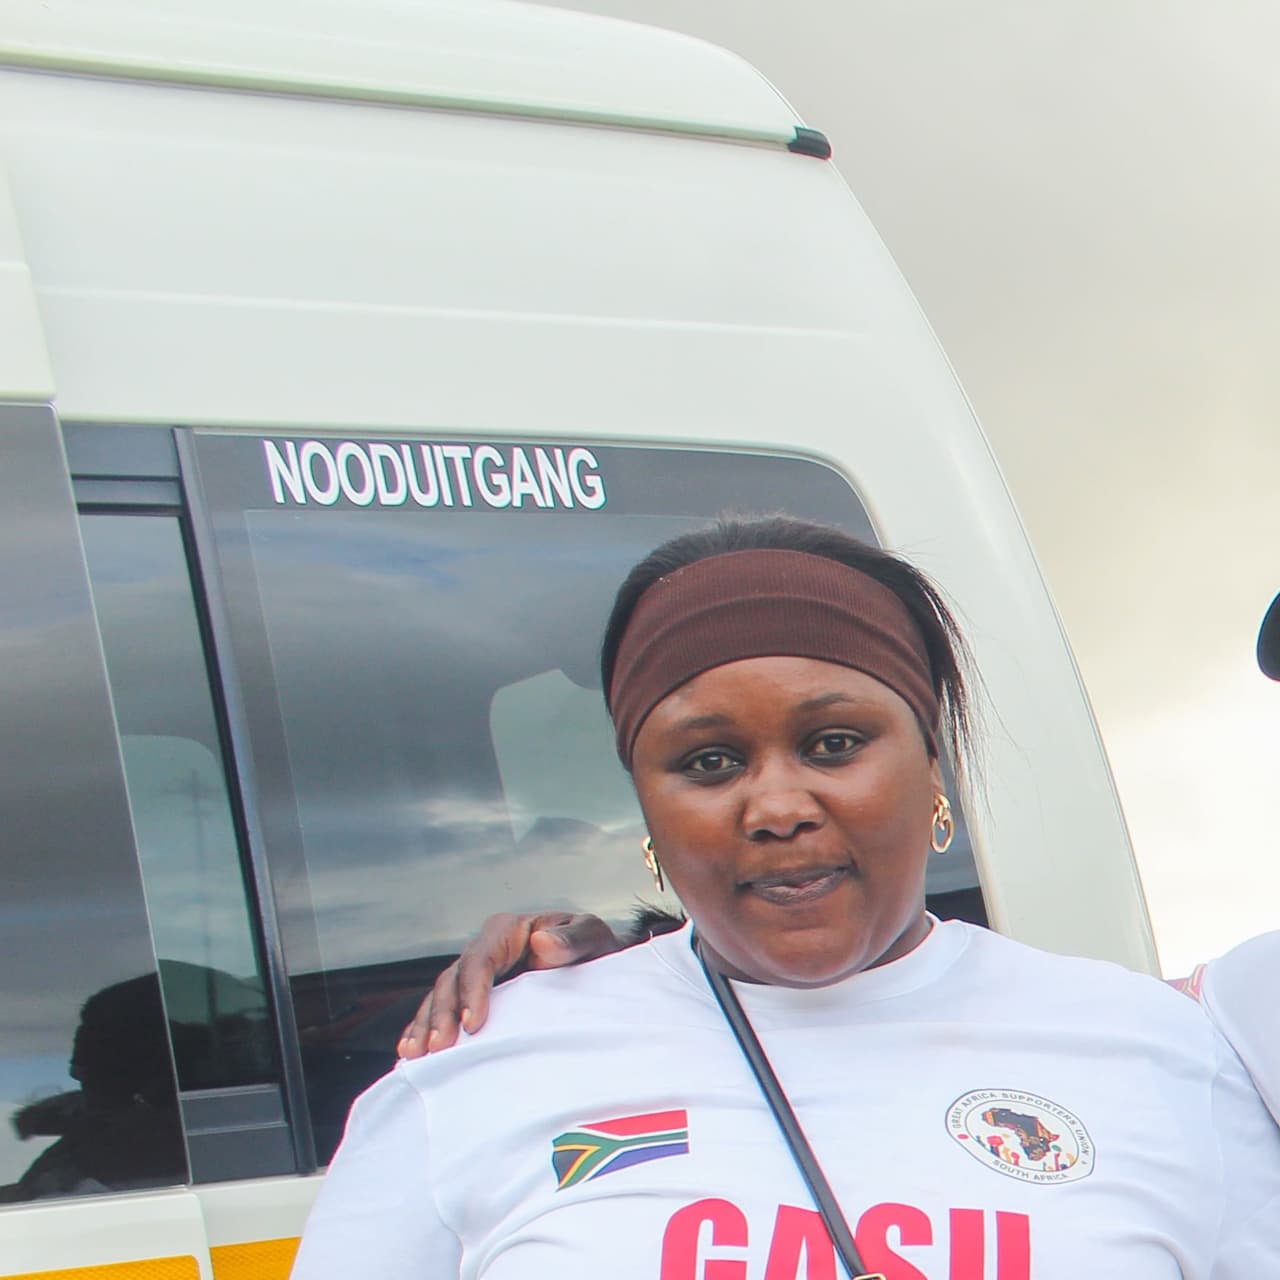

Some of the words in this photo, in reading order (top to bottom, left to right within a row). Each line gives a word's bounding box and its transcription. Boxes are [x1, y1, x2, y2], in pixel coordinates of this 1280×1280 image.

[263, 439, 607, 510] NOODUITGANG
[961, 1092, 997, 1107] AFRICA
[1001, 1093, 1077, 1126] SUPPORTERS
[992, 1159, 1030, 1179] SOUTH
[1033, 1173, 1069, 1181] AFRICA
